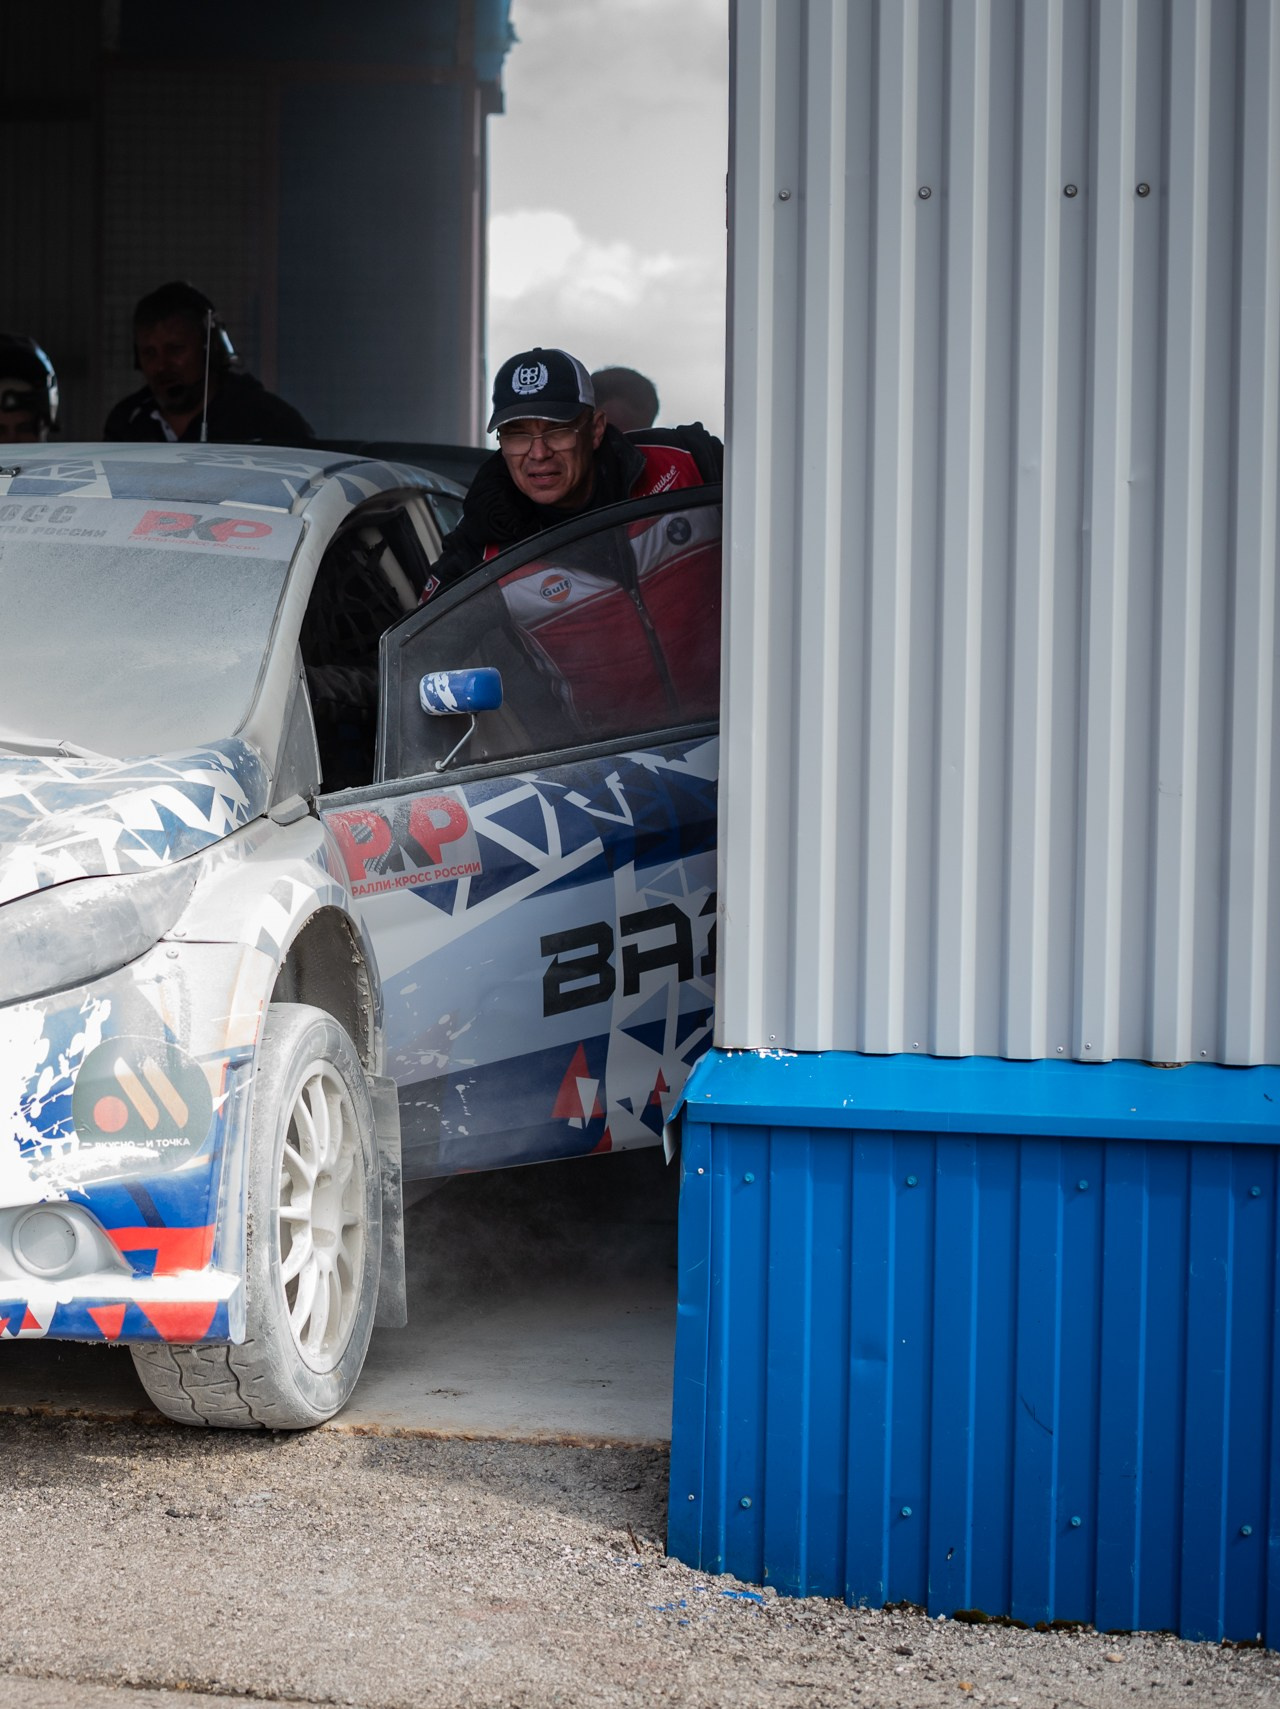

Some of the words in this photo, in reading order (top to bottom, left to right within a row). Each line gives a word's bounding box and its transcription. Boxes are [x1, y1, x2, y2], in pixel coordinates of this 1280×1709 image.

[542, 579, 570, 597] Gulf
[352, 871, 433, 897] РАЛЛИ-КРОСС
[435, 861, 481, 880] РОССИИ
[156, 1137, 191, 1147] ТОЧКА
